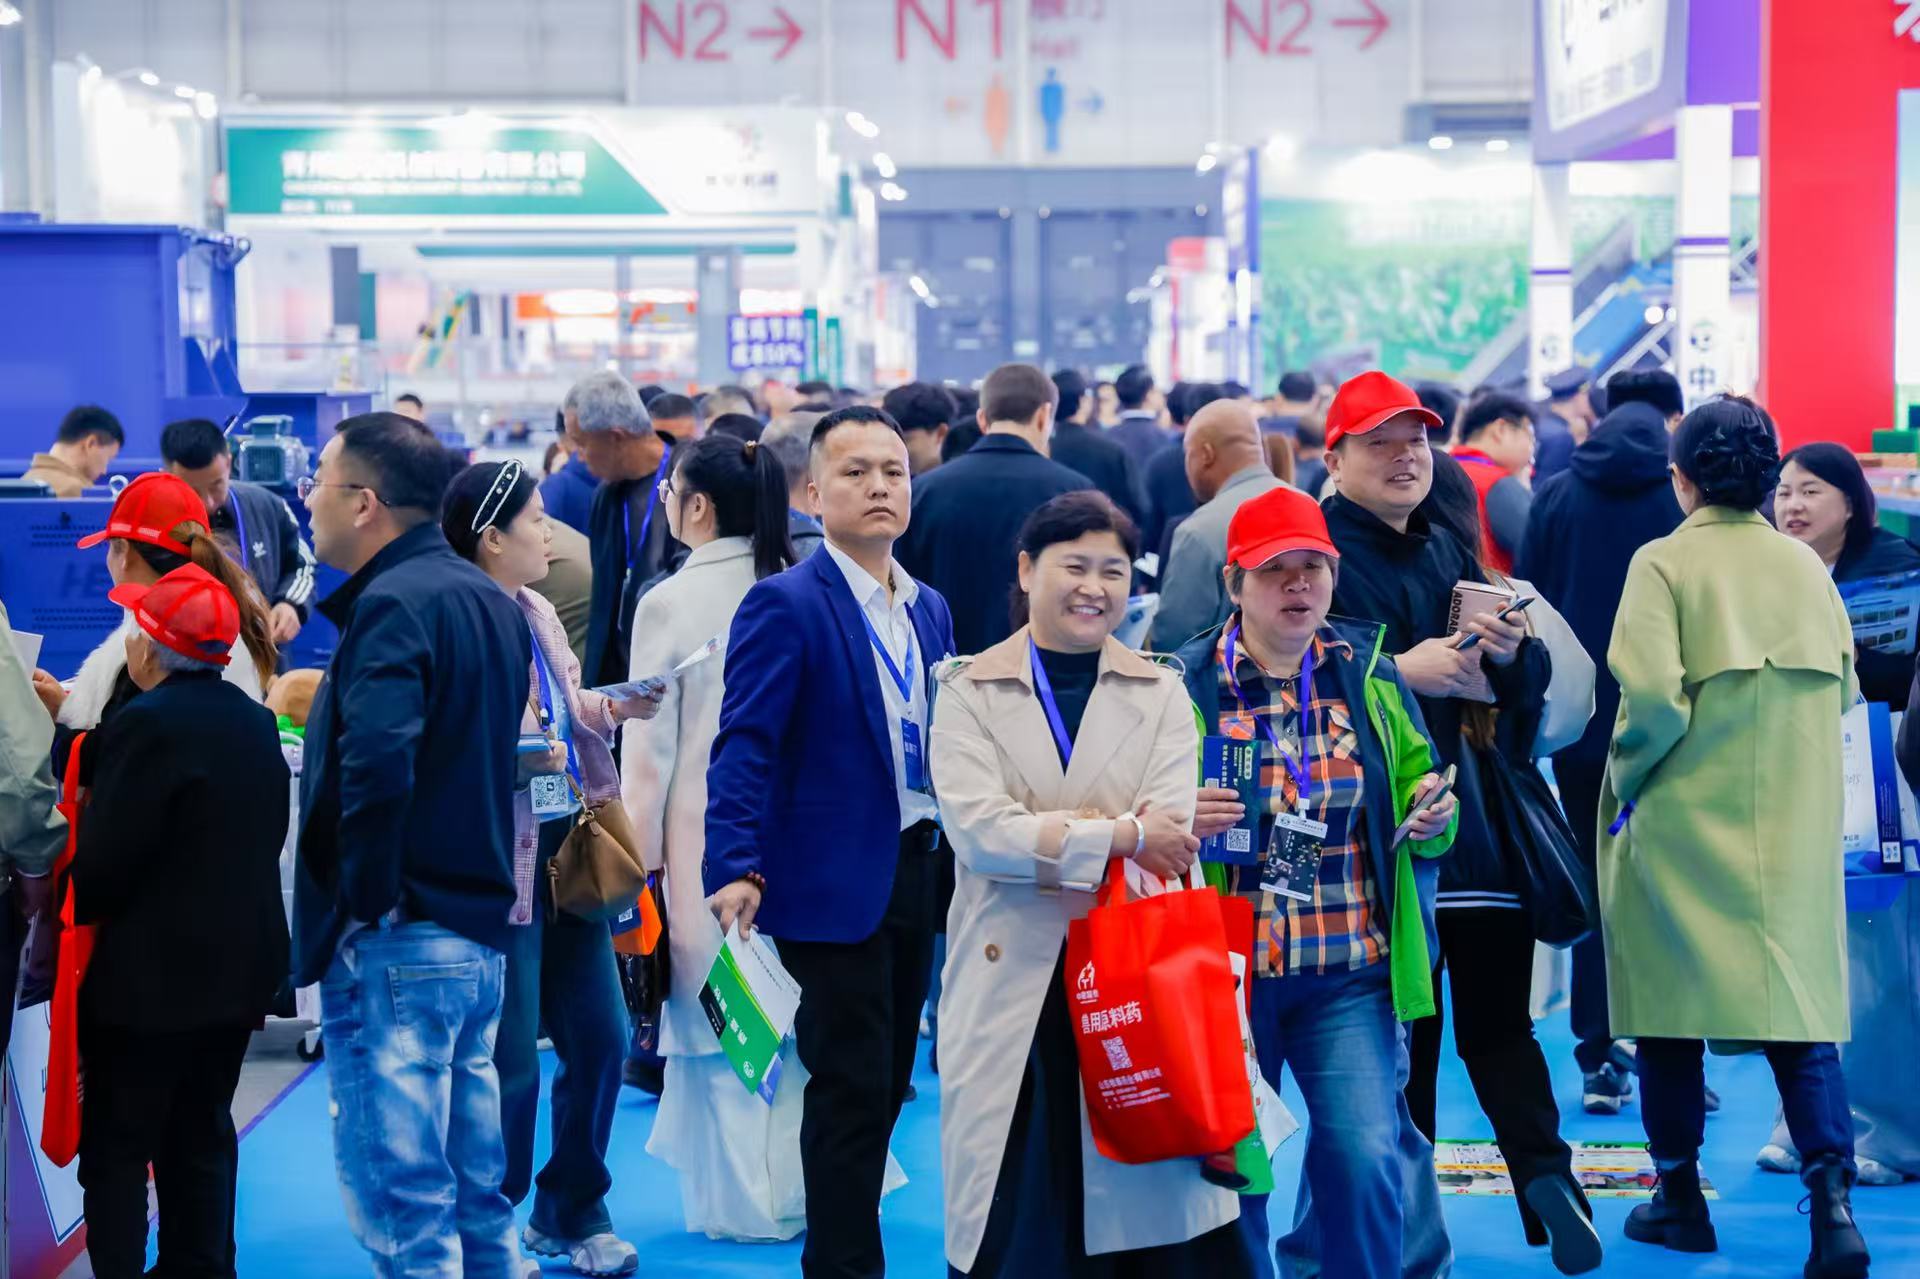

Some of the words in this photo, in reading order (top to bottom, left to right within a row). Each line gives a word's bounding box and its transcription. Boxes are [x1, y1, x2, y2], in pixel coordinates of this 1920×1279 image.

[637, 0, 731, 61] N2
[895, 0, 1003, 60] N1
[1223, 0, 1312, 58] N2
[1448, 591, 1463, 637] ADORAB
[1081, 1001, 1142, 1034] 兽用原料药
